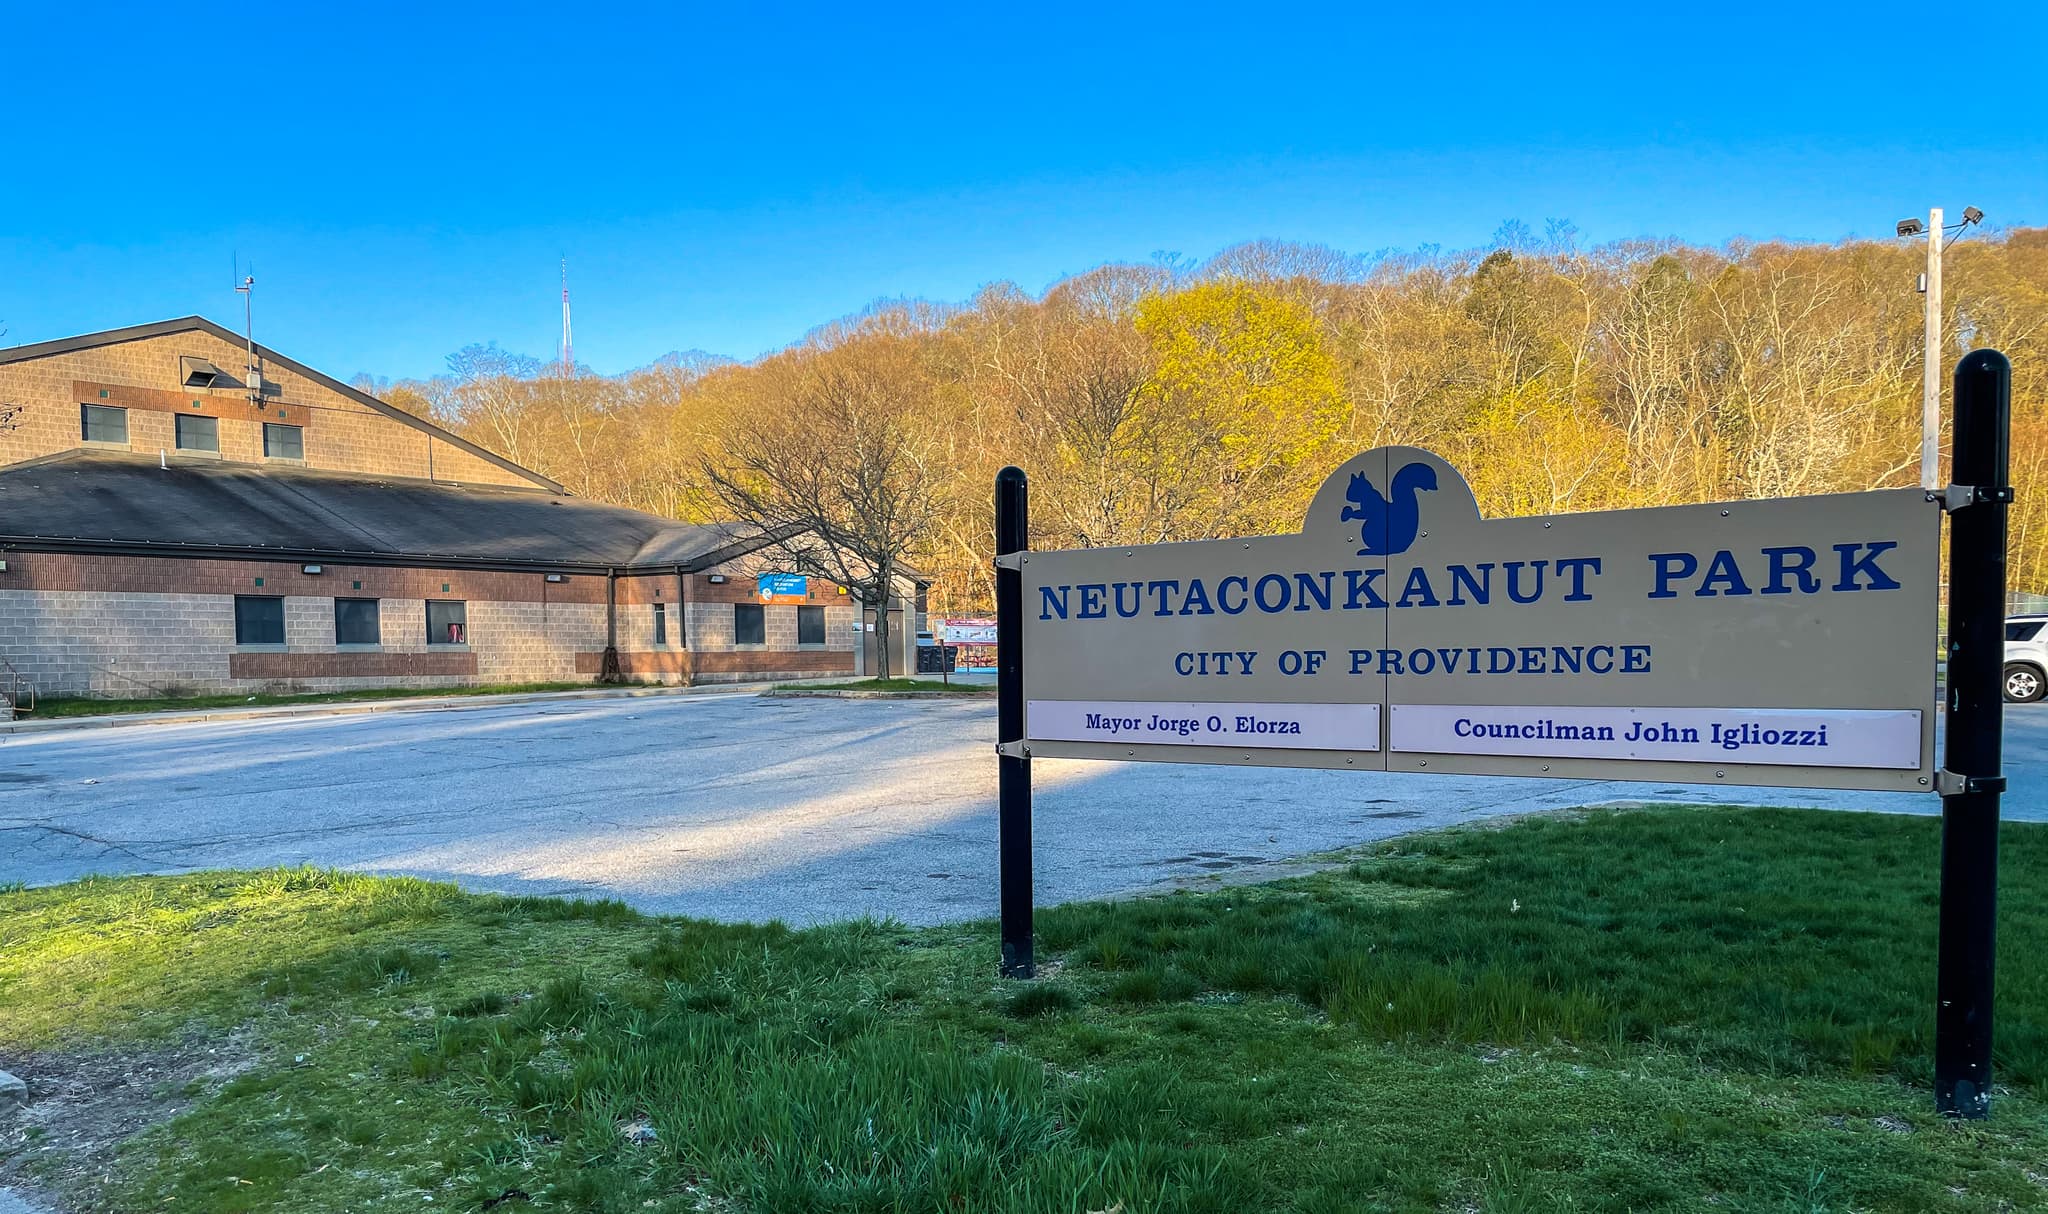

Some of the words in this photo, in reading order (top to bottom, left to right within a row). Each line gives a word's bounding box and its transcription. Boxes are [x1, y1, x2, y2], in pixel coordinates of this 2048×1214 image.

[1038, 557, 1602, 620] NEUTACONKANUT
[1647, 541, 1901, 598] PARK
[1174, 651, 1258, 676] CITY
[1278, 650, 1327, 676] OF
[1348, 645, 1651, 675] PROVIDENCE
[1085, 713, 1142, 731] Mayor
[1146, 715, 1200, 736] Jorge
[1206, 715, 1228, 733] O.
[1235, 716, 1301, 735] Elorza
[1453, 718, 1615, 742] Councilman
[1624, 721, 1700, 743] John
[1710, 723, 1829, 750] Igliozzi
